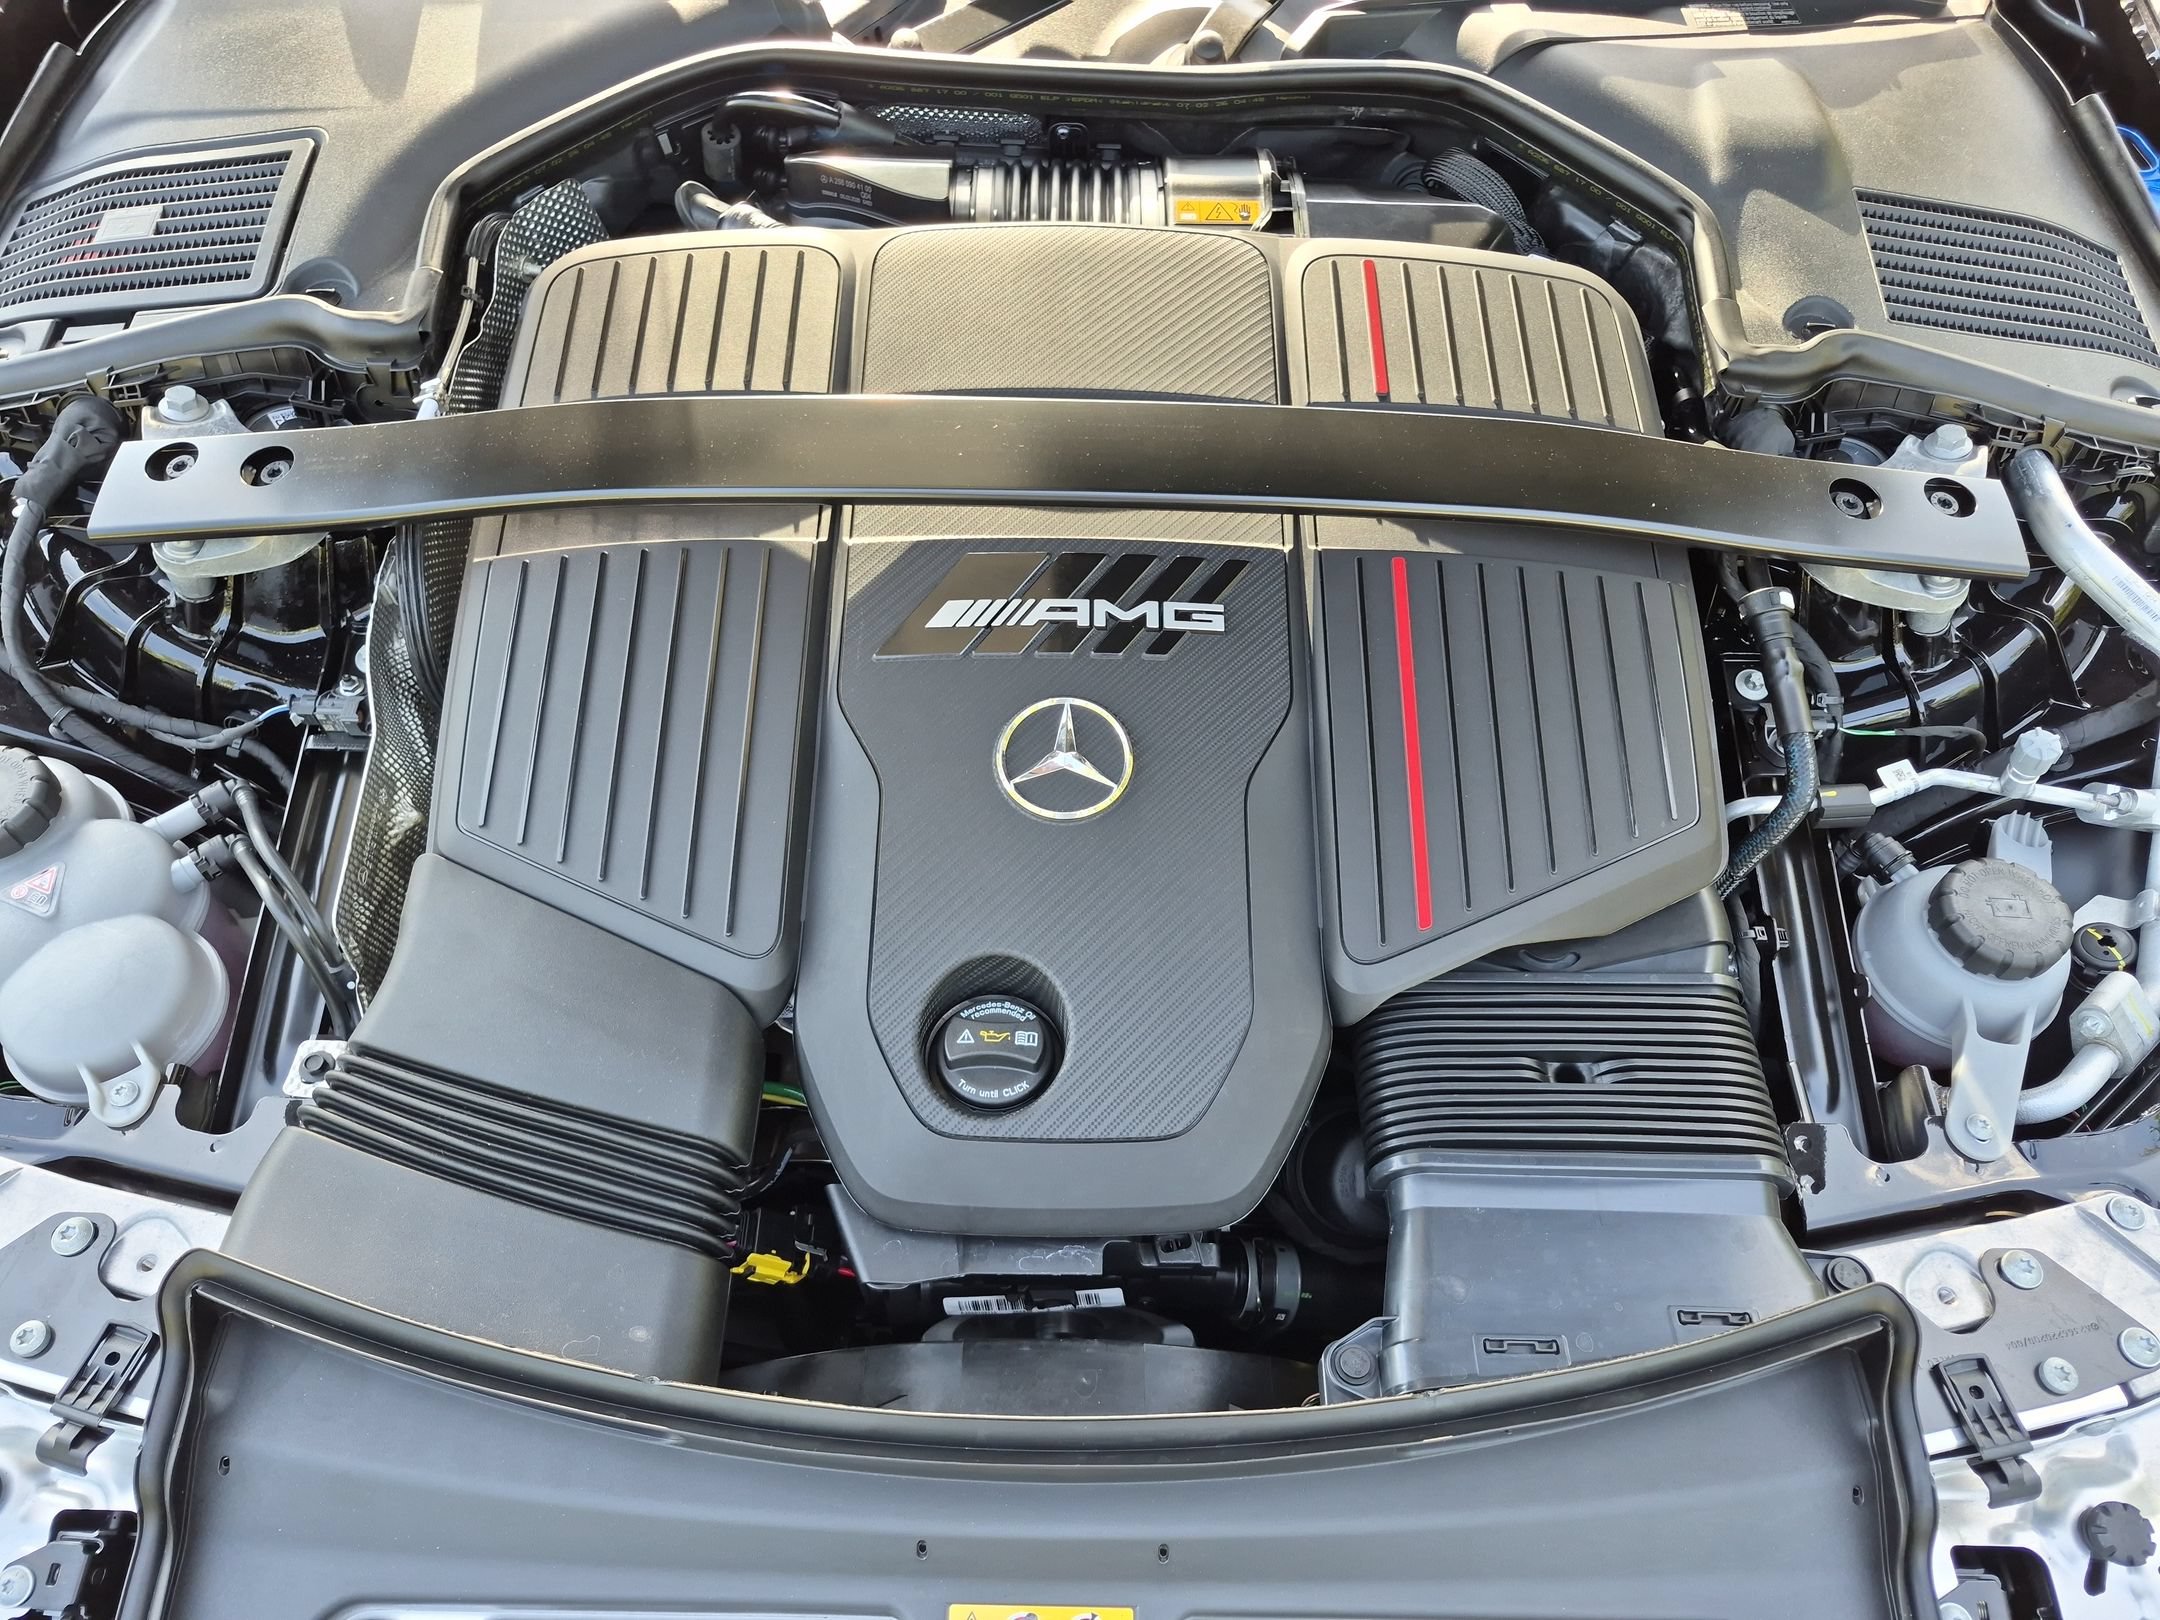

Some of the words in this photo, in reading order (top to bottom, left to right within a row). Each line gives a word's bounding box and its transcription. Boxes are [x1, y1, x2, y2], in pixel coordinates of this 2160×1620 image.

[1020, 598, 1225, 633] AMG
[960, 1001, 1025, 1018] Mercedes-Benz
[1025, 1010, 1037, 1021] Oil
[970, 1007, 1028, 1022] recommended
[958, 1079, 976, 1095] Turn
[979, 1089, 999, 1098] until
[1003, 1080, 1030, 1097] CLICK
